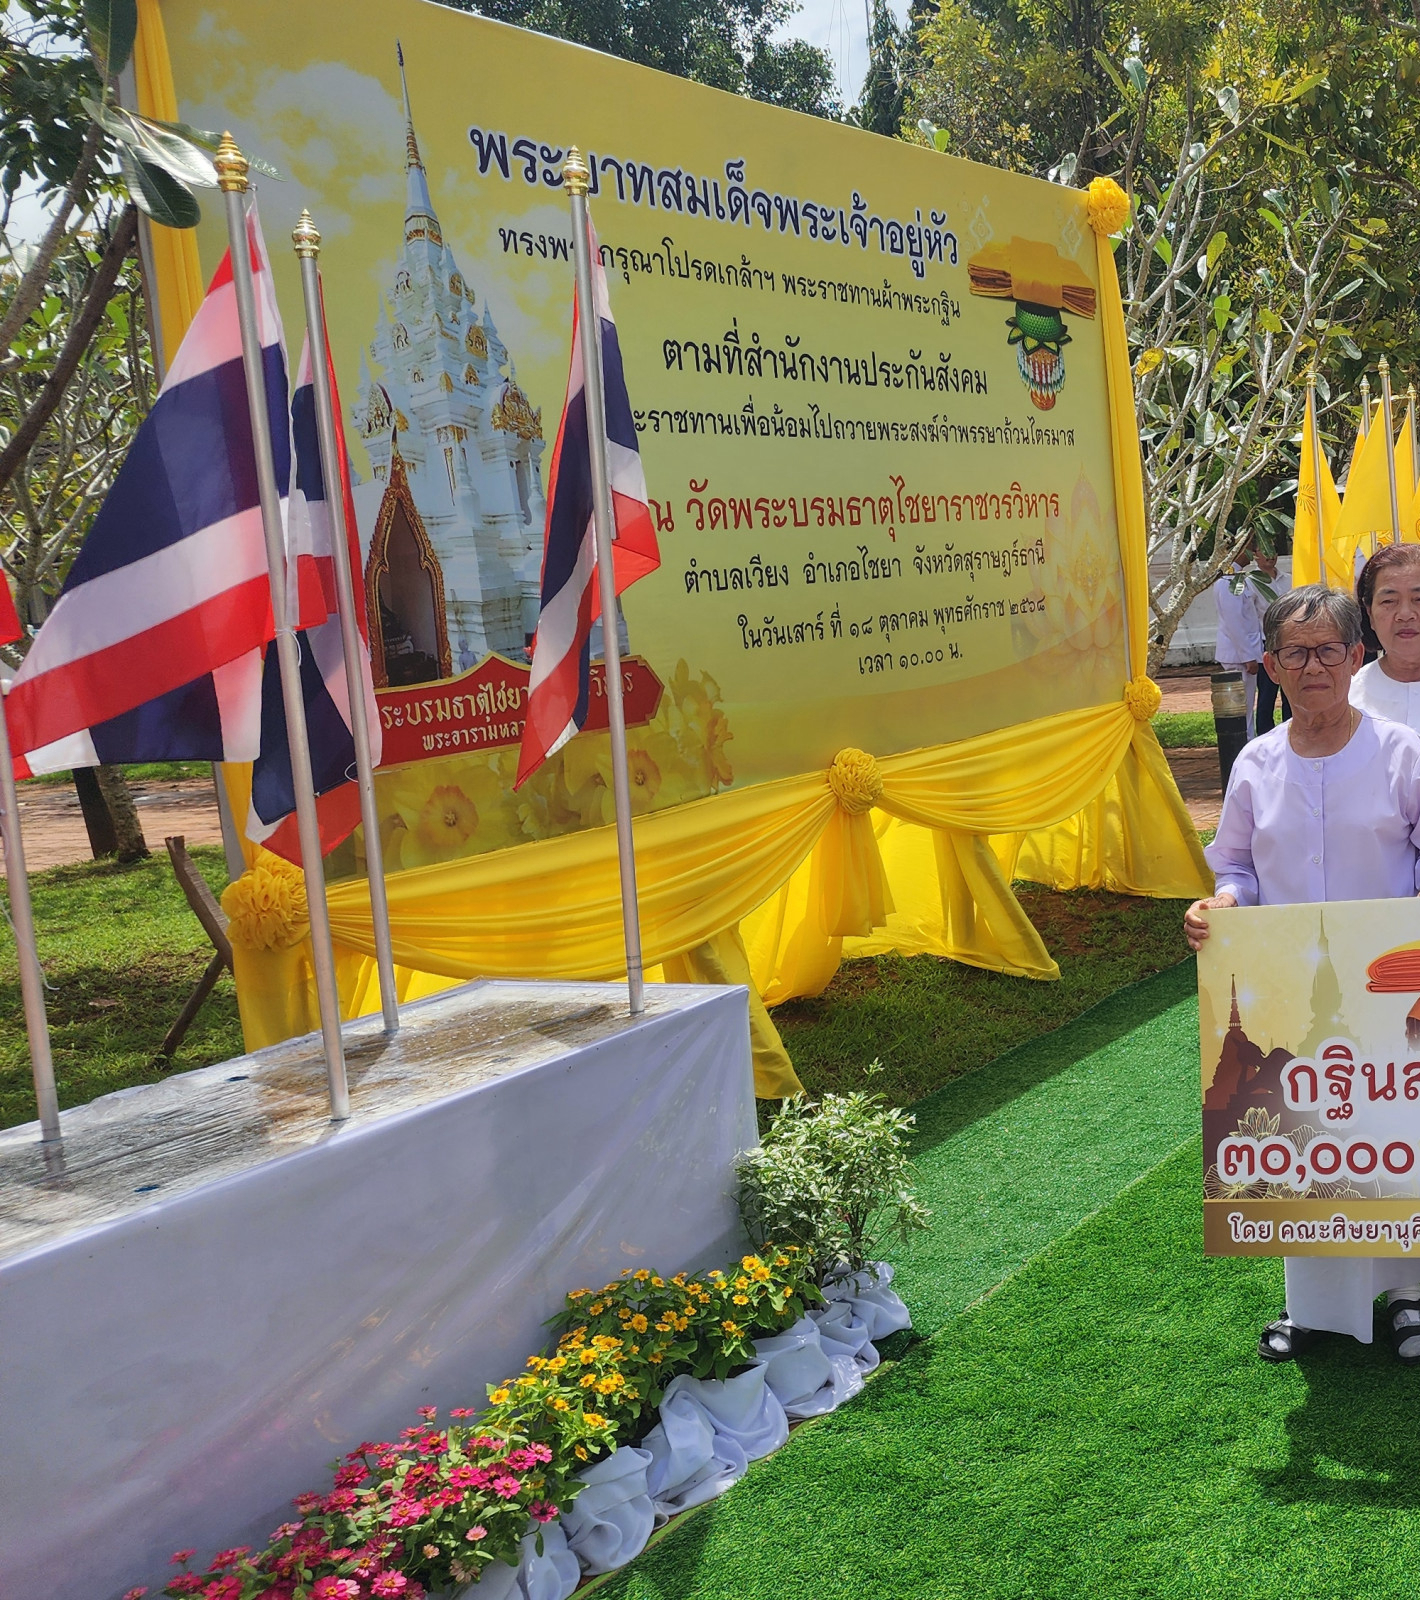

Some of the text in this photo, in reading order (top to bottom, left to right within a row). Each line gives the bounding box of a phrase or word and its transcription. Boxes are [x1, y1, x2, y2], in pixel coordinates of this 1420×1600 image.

[498, 227, 961, 326] ทรงพกรุณาโปรดเกล้าฯ พระราชทานผ้าพระกฐิน
[662, 317, 988, 395] ตามที่สำนักงานประกันสังคม
[633, 394, 1075, 447] ะราชทานเพื่อน้อมไปถวายพระสงฆ์จำพรรษาถ้วนไตรมาส
[686, 474, 1060, 543] วัดพระบรมธาตุไชยาราชวรวิหาร
[684, 537, 1046, 594] ตำบลเวียง อำเภอไชยา จังหวัดสุราษฎร์ธานี
[737, 594, 1046, 649] ในวันเสาร์ ที่ ๑๘ ตุลาคม พุทธศักราช ๒๕๖๘
[858, 642, 963, 675] เวลา ๑๐.๐๐ น.
[421, 719, 526, 751] พระอารามหล
[1222, 1140, 1416, 1184] ๓๐,๐๐๐
[1229, 1215, 1271, 1240] โดย
